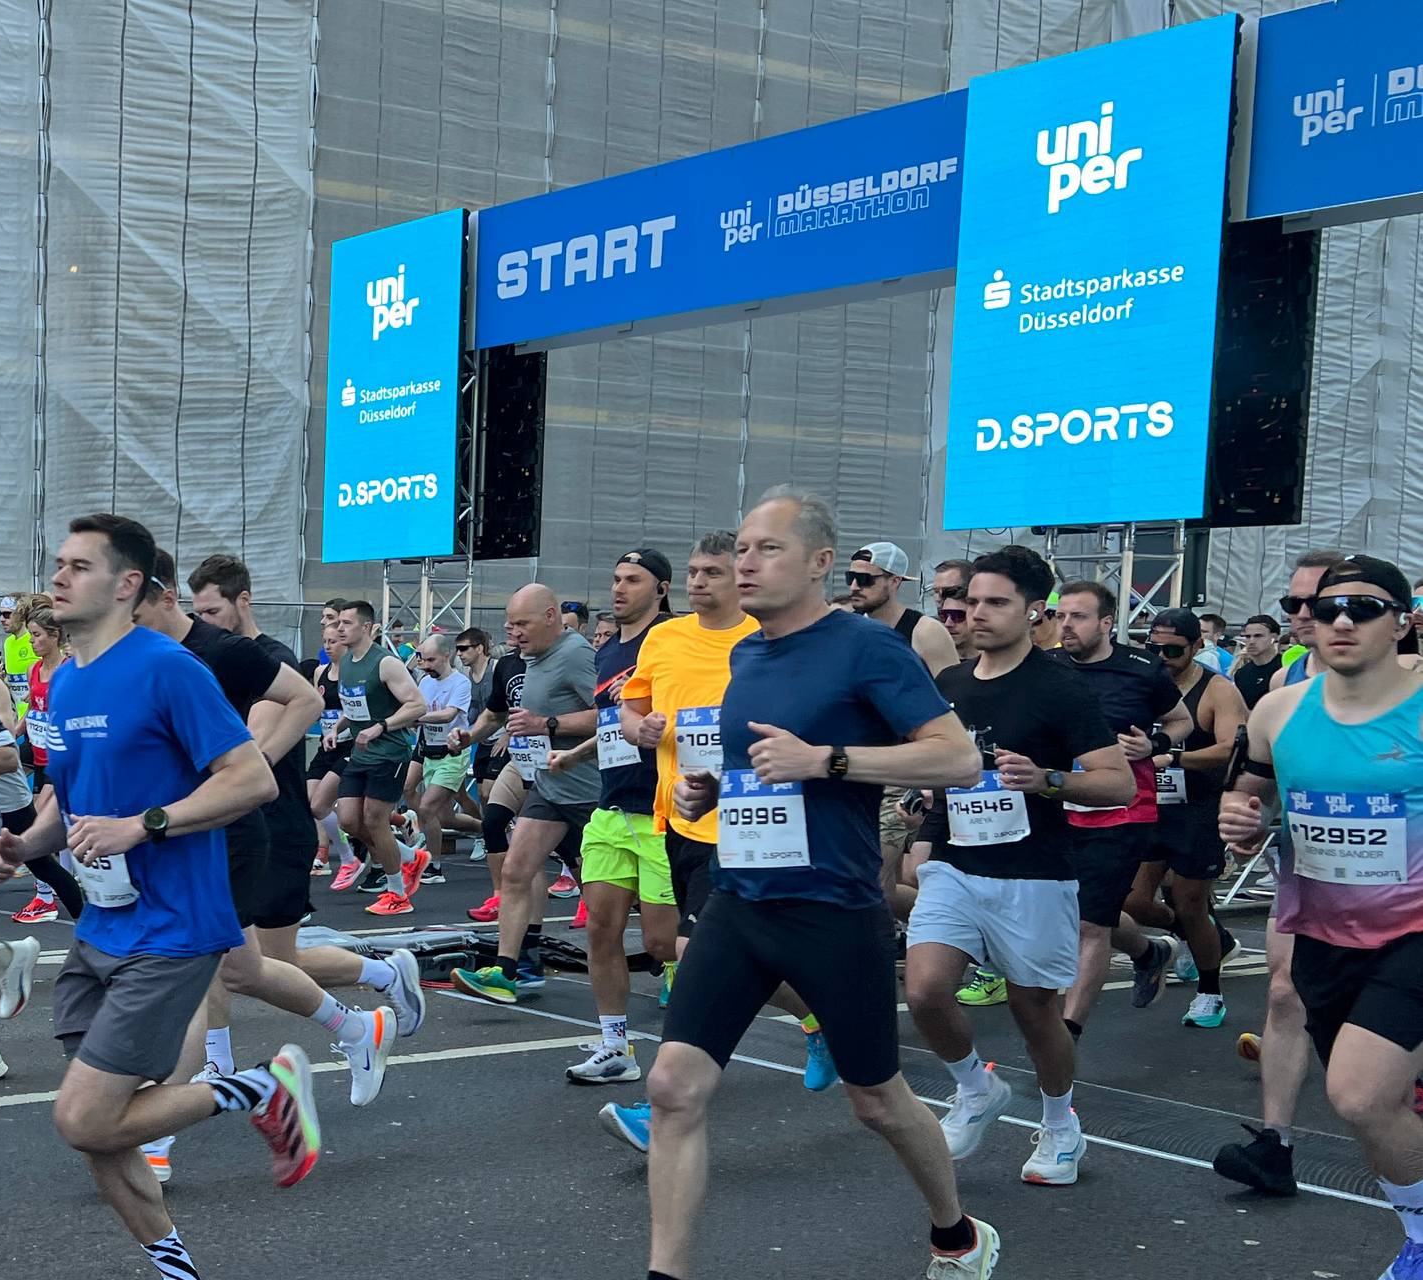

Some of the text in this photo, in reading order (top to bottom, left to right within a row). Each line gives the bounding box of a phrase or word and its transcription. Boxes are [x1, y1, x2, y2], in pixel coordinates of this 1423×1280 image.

[1293, 78, 1346, 117] uni
[1036, 100, 1114, 166] uni
[1301, 105, 1364, 146] per
[777, 156, 958, 215] DÜSSELDORF
[1047, 146, 1143, 215] per
[720, 200, 752, 230] uni
[774, 185, 930, 237] MARATHON
[724, 221, 763, 252] per
[496, 215, 677, 300] START
[366, 263, 406, 307] uni
[1019, 263, 1185, 305] Stadtsparkasse
[372, 297, 419, 341] per
[1018, 297, 1135, 334] Düsseldorf
[359, 378, 441, 404] Stadtsparkasse
[358, 401, 417, 424] Düsseldorf
[975, 399, 1174, 453] D.SPORTS
[338, 472, 438, 508] D.SPORTS
[723, 806, 787, 826] 10996
[953, 797, 1014, 815] 14546
[1299, 823, 1388, 846] 12952
[1339, 848, 1385, 859] SANDER
